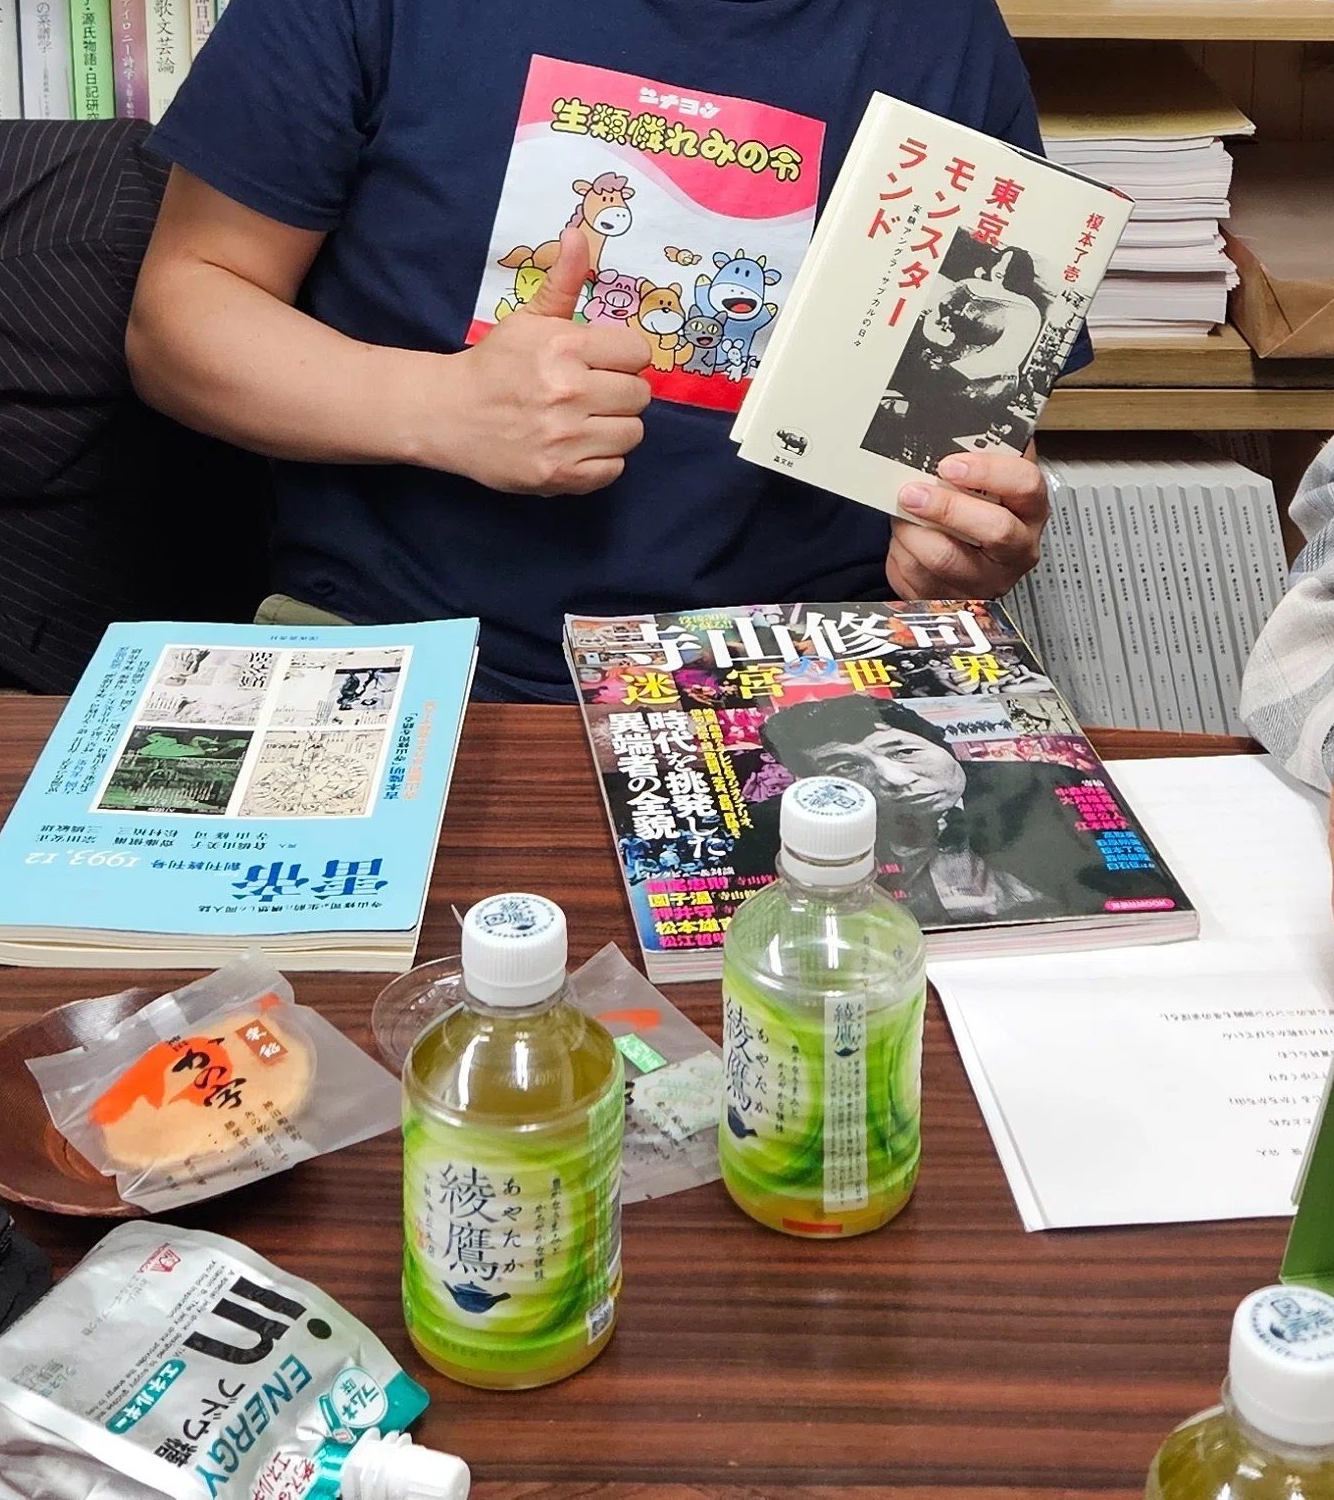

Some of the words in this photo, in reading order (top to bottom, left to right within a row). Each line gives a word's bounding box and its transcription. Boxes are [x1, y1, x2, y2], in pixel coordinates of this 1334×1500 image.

[549, 97, 804, 183] 生類憐れみの令
[866, 137, 930, 244] ランド
[968, 174, 1025, 248] 東京
[853, 203, 923, 349] 実験アングラ・サブカルの日々
[886, 156, 977, 330] モンスター
[1062, 210, 1109, 283] 榎本了壱
[771, 455, 797, 470] 晶文社
[604, 606, 996, 674] 寺山修司
[619, 651, 1010, 707] 迷宮の世界
[382, 764, 403, 801] 吉本隆明
[607, 711, 680, 842] 異端者の全貌
[646, 710, 730, 861] 時代を挑発した
[23, 850, 142, 870] 1993.12
[149, 858, 242, 874] 創刊終刊号
[189, 838, 268, 852] 倉橋由美子
[193, 828, 270, 841] 寺山修司
[231, 856, 391, 902] 雷帝
[647, 893, 713, 909] 園子温
[650, 905, 717, 922] 押井守
[833, 1002, 859, 1047] 綾鷹
[753, 1027, 771, 1115] あやたか
[437, 1160, 500, 1283] 綾鷹
[501, 1176, 525, 1275] あやたか
[181, 1274, 334, 1368] in
[113, 1363, 181, 1431] エネルギー
[153, 1377, 247, 1469] ブドウ糖
[193, 1353, 315, 1500] ENERGY
[341, 1384, 381, 1421] ラムネ
